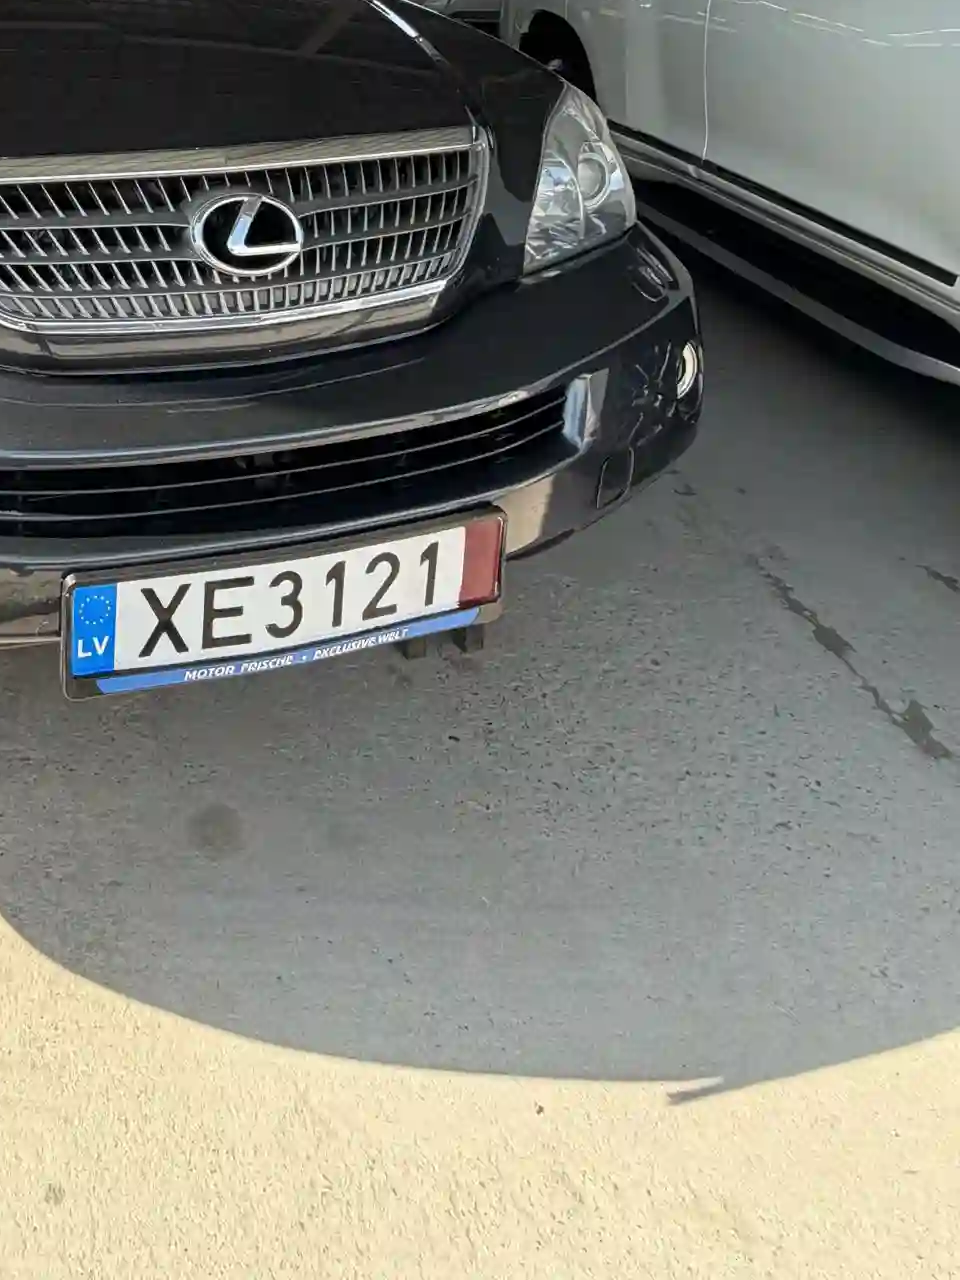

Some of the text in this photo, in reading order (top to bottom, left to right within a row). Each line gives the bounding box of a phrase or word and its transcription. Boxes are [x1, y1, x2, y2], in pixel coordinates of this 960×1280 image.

[138, 542, 440, 658] XE3121
[77, 634, 110, 659] LV
[184, 664, 235, 681] MOTOR
[378, 628, 410, 645] WELT
